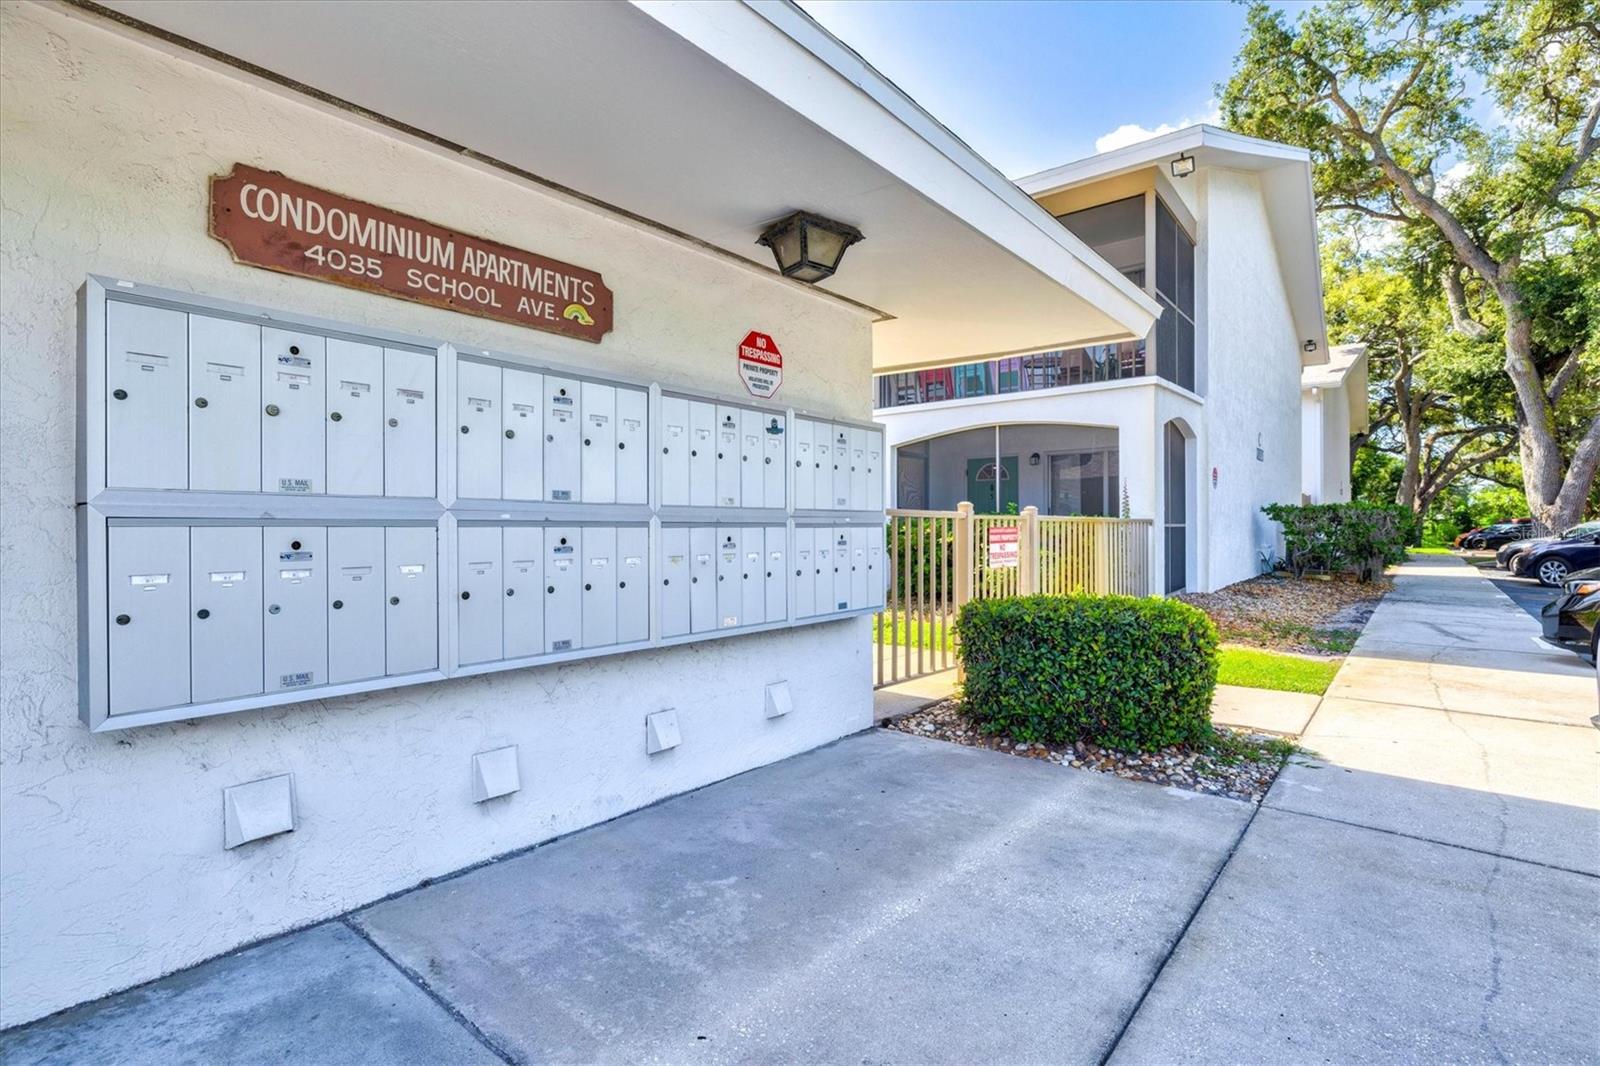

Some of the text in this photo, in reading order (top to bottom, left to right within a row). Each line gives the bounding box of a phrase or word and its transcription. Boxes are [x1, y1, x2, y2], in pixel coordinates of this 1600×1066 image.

[239, 183, 596, 306] CONDOMINIUM APARTMENTS
[304, 245, 560, 321] 4035 SCHOOL AVE.
[741, 345, 781, 364] TRESPASSING
[756, 336, 767, 349] NO
